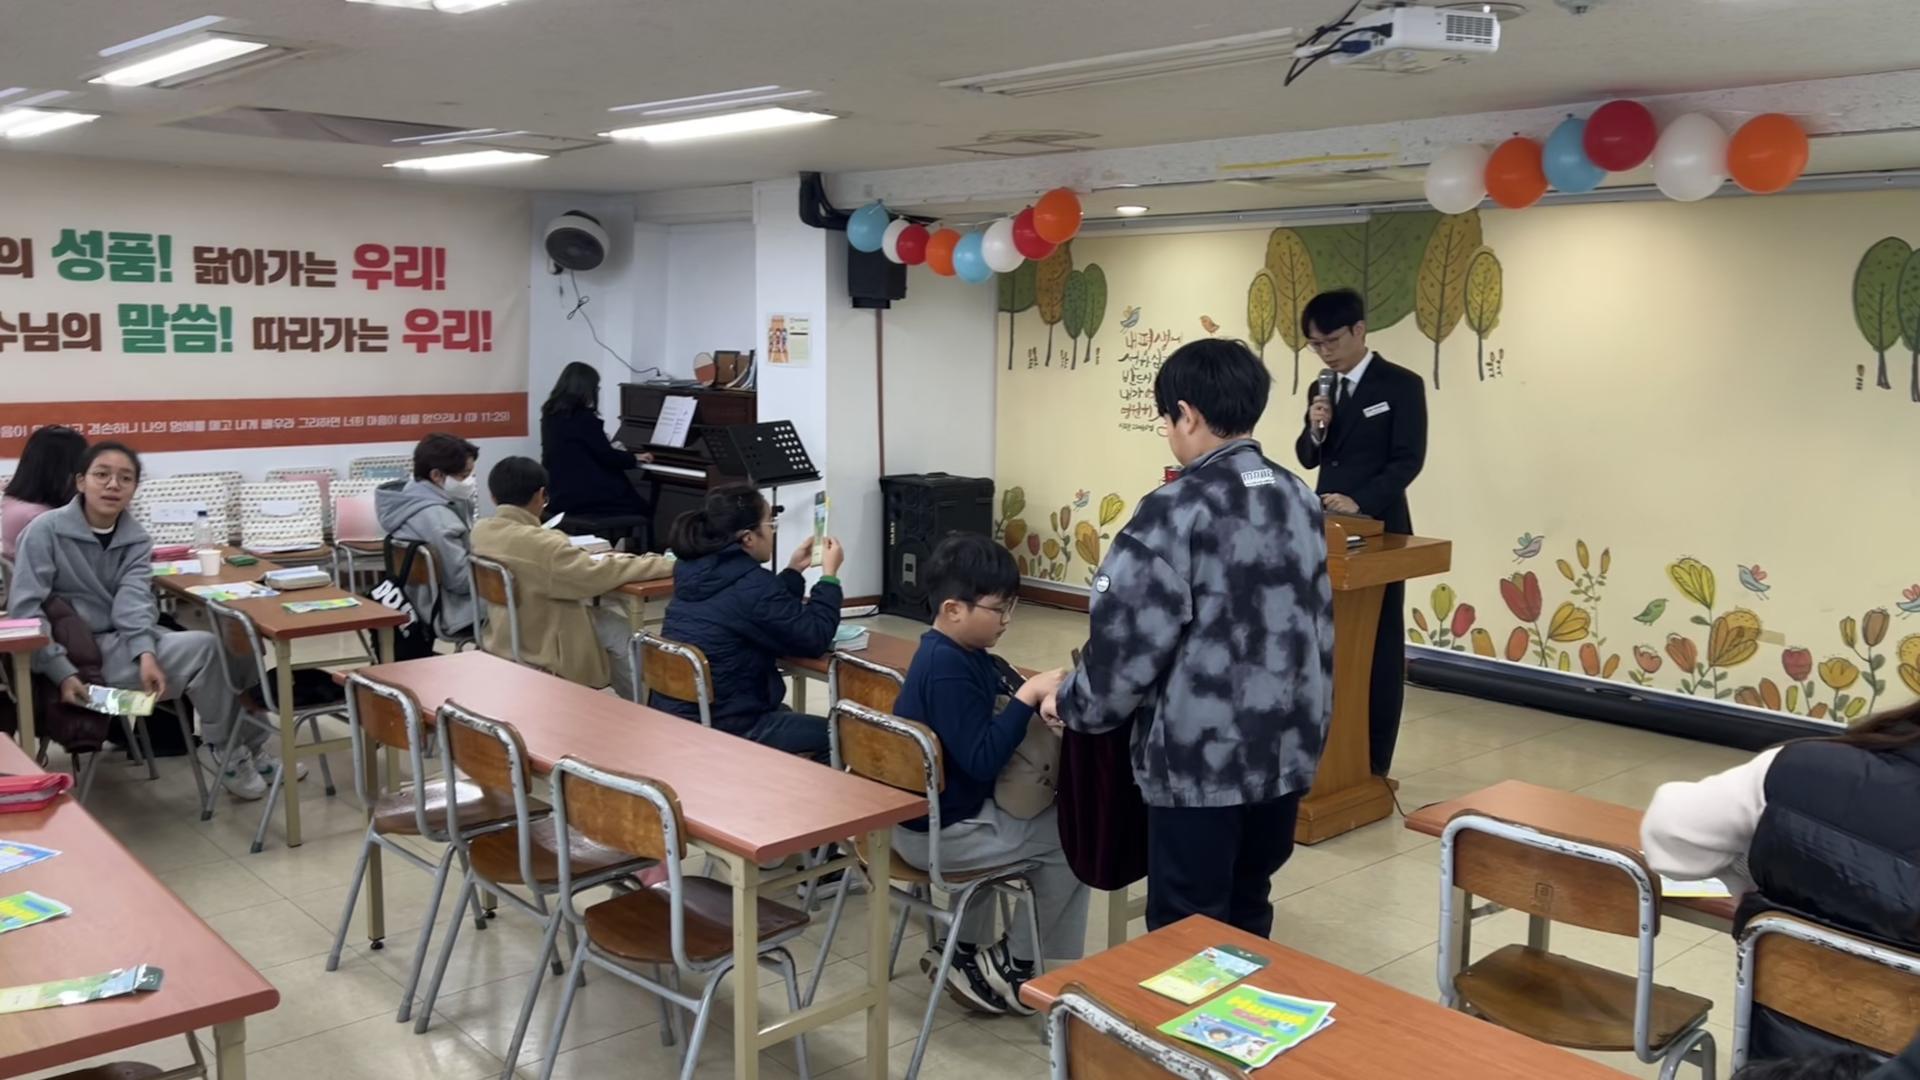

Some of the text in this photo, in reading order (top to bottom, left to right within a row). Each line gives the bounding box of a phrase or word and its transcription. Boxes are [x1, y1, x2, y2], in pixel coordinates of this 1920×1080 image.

[0, 229, 446, 291] 의 성품! 닮아가는 우리!
[118, 303, 233, 354] 말씀!
[252, 316, 389, 353] 따라가는
[402, 308, 493, 353] 우리!
[1118, 349, 1168, 370] 선하심
[87, 421, 139, 436] 겸손하니
[141, 420, 168, 433] 나의
[235, 417, 259, 431] 내게
[299, 415, 341, 428] 그리하면
